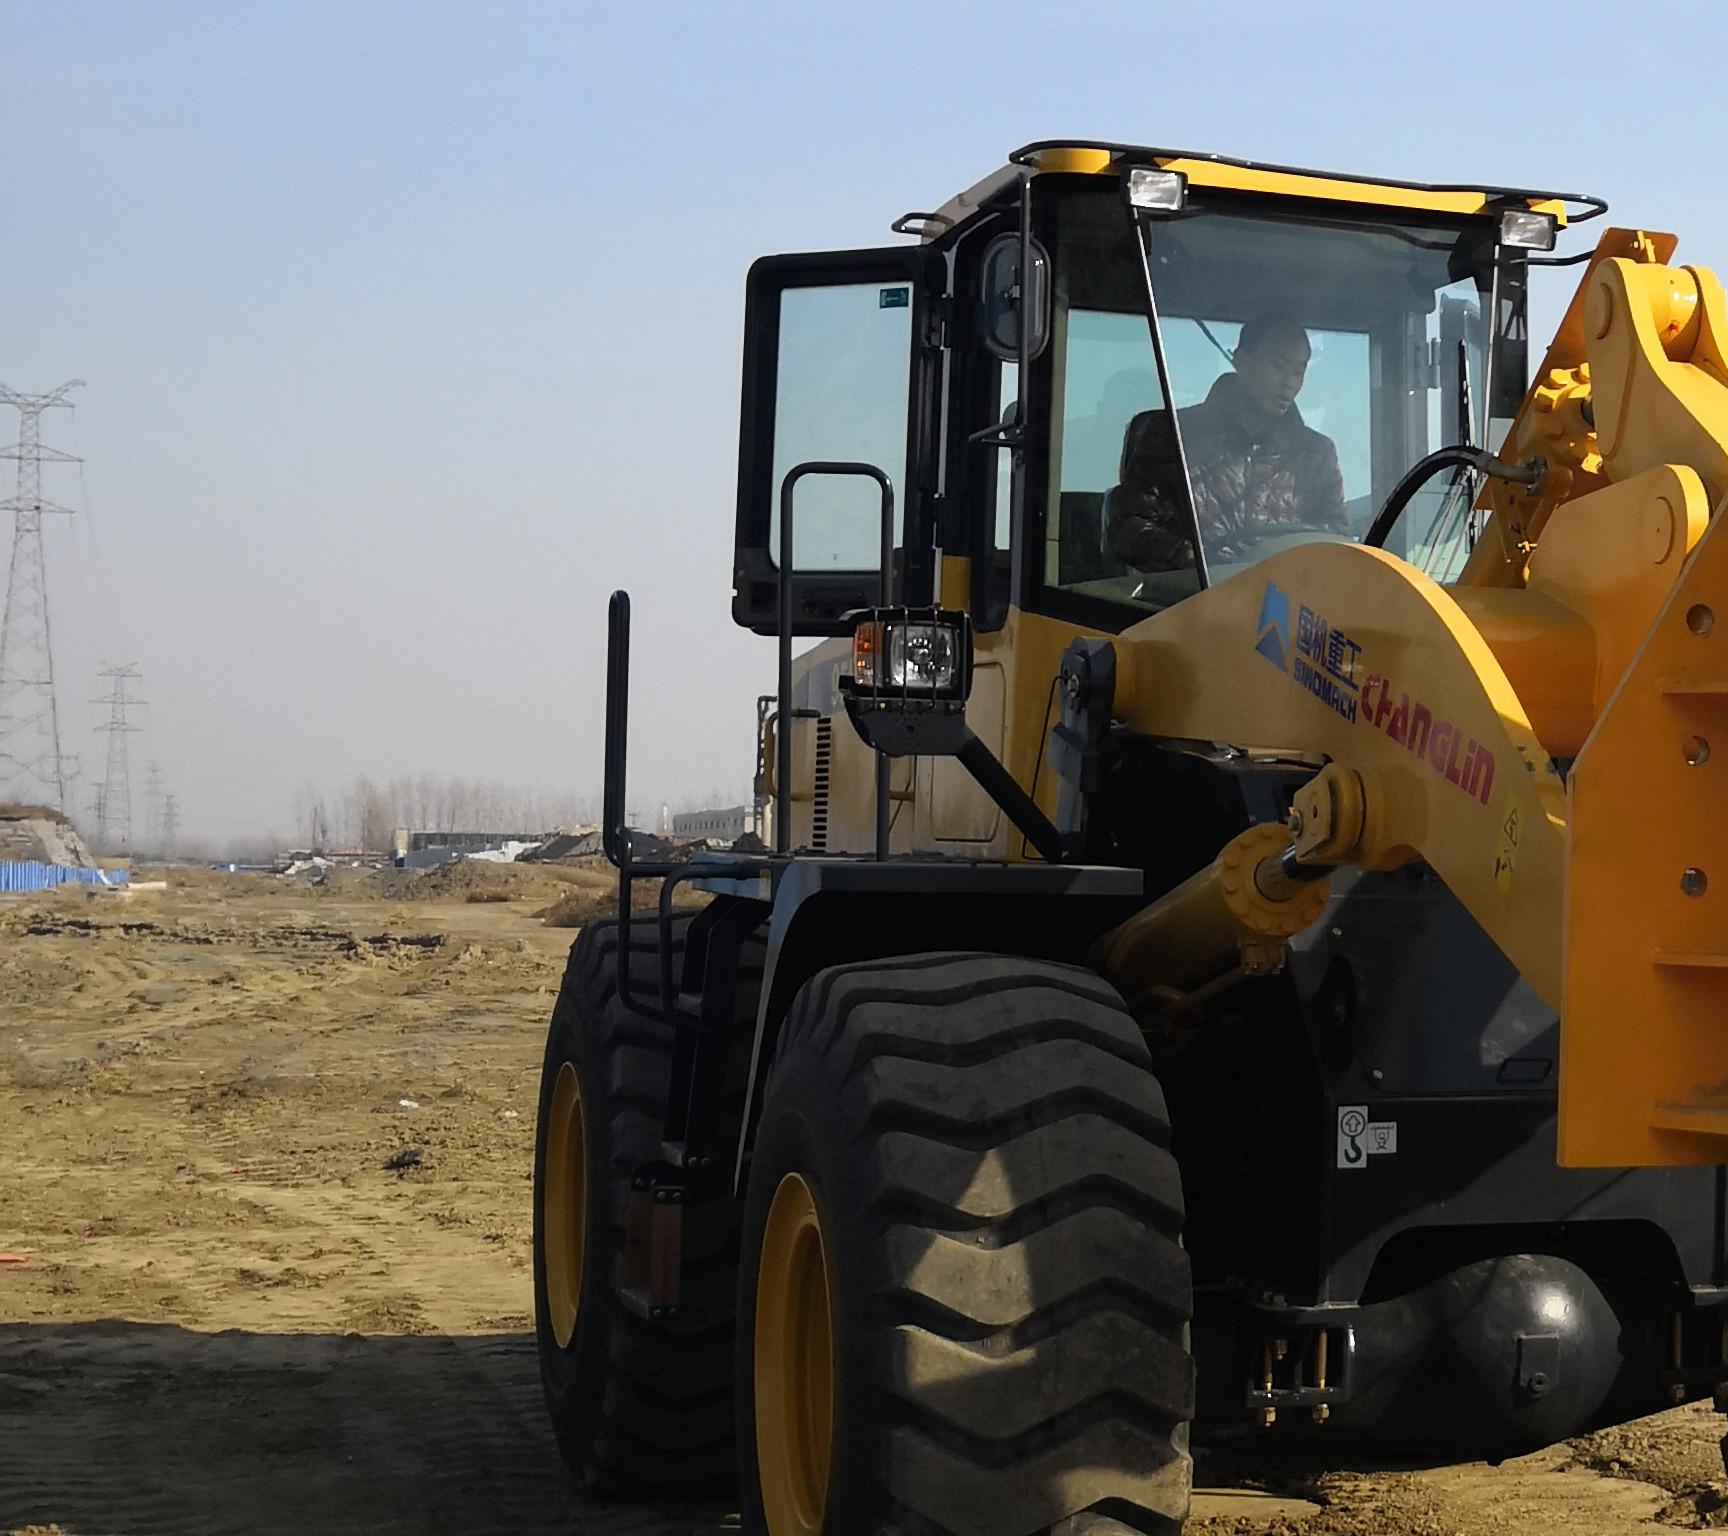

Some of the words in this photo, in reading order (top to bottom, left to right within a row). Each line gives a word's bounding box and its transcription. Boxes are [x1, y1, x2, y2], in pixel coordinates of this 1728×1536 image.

[1296, 604, 1362, 692] 国机重工
[1293, 657, 1357, 725] SINOMACH
